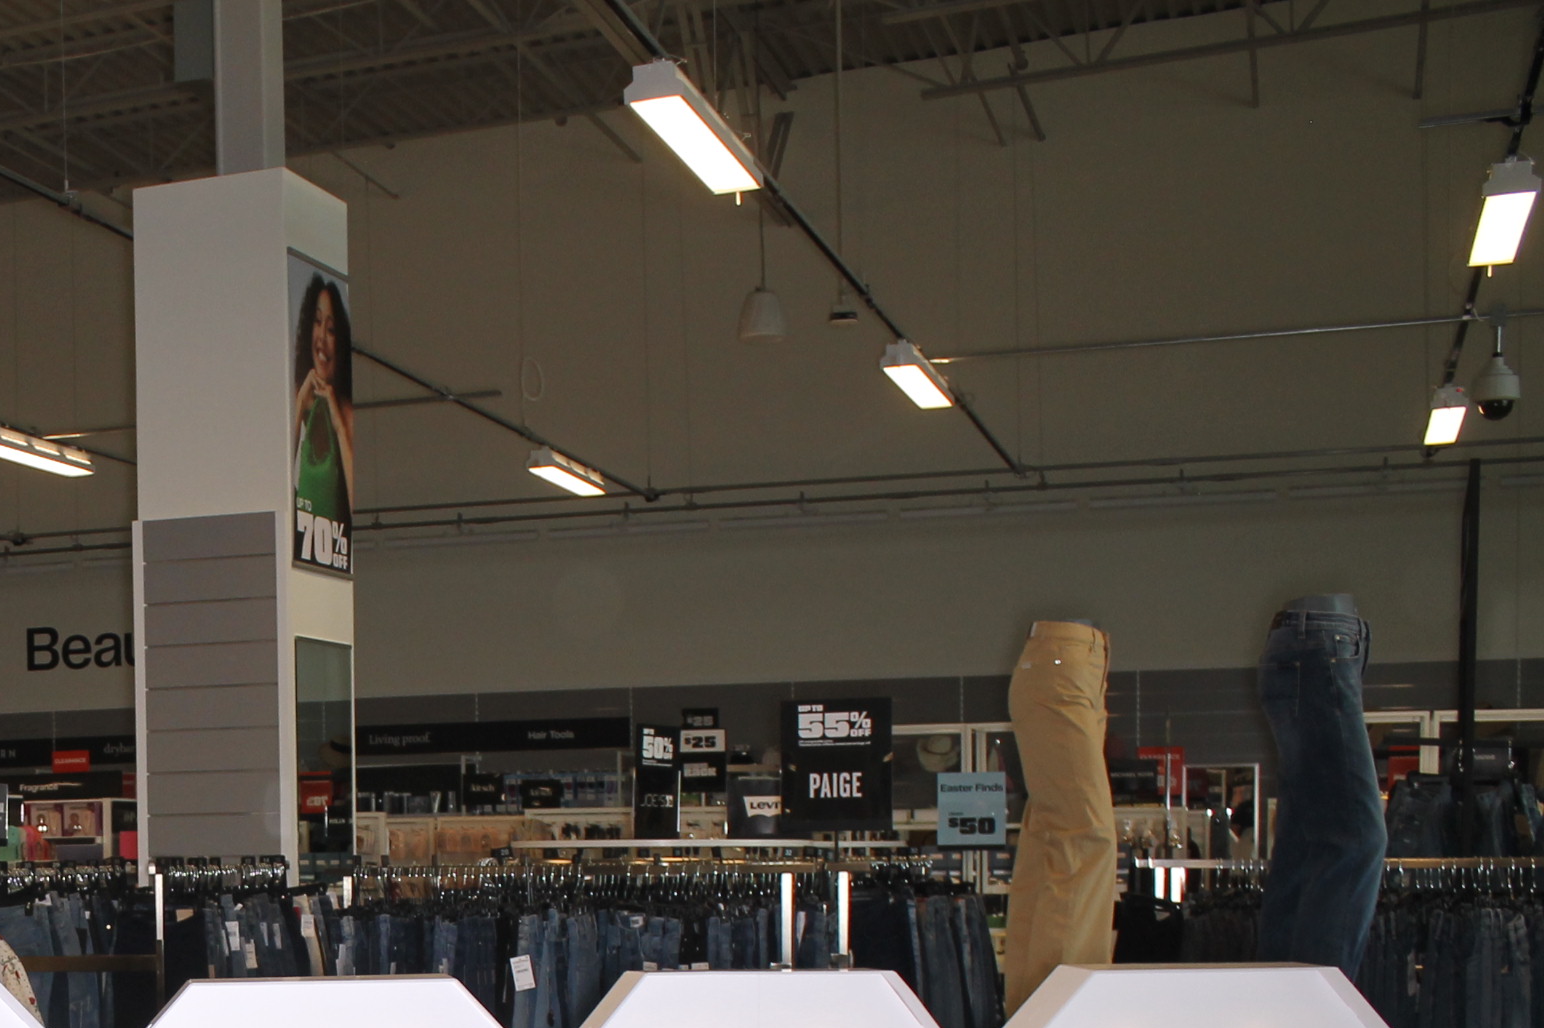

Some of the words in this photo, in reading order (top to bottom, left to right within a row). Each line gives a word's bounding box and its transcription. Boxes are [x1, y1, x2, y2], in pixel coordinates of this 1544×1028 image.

[296, 509, 348, 566] 70%
[332, 553, 348, 569] OFF
[797, 711, 872, 739] 55%
[850, 728, 872, 737] OFF
[368, 734, 400, 747] Living
[528, 730, 547, 739] Hair
[549, 730, 575, 739] Tools
[684, 736, 717, 748] $25
[642, 735, 674, 760] 50%
[809, 772, 863, 799] PAIGE
[940, 784, 973, 792] Easter
[975, 783, 1004, 792] Finds
[948, 817, 996, 835] $50
